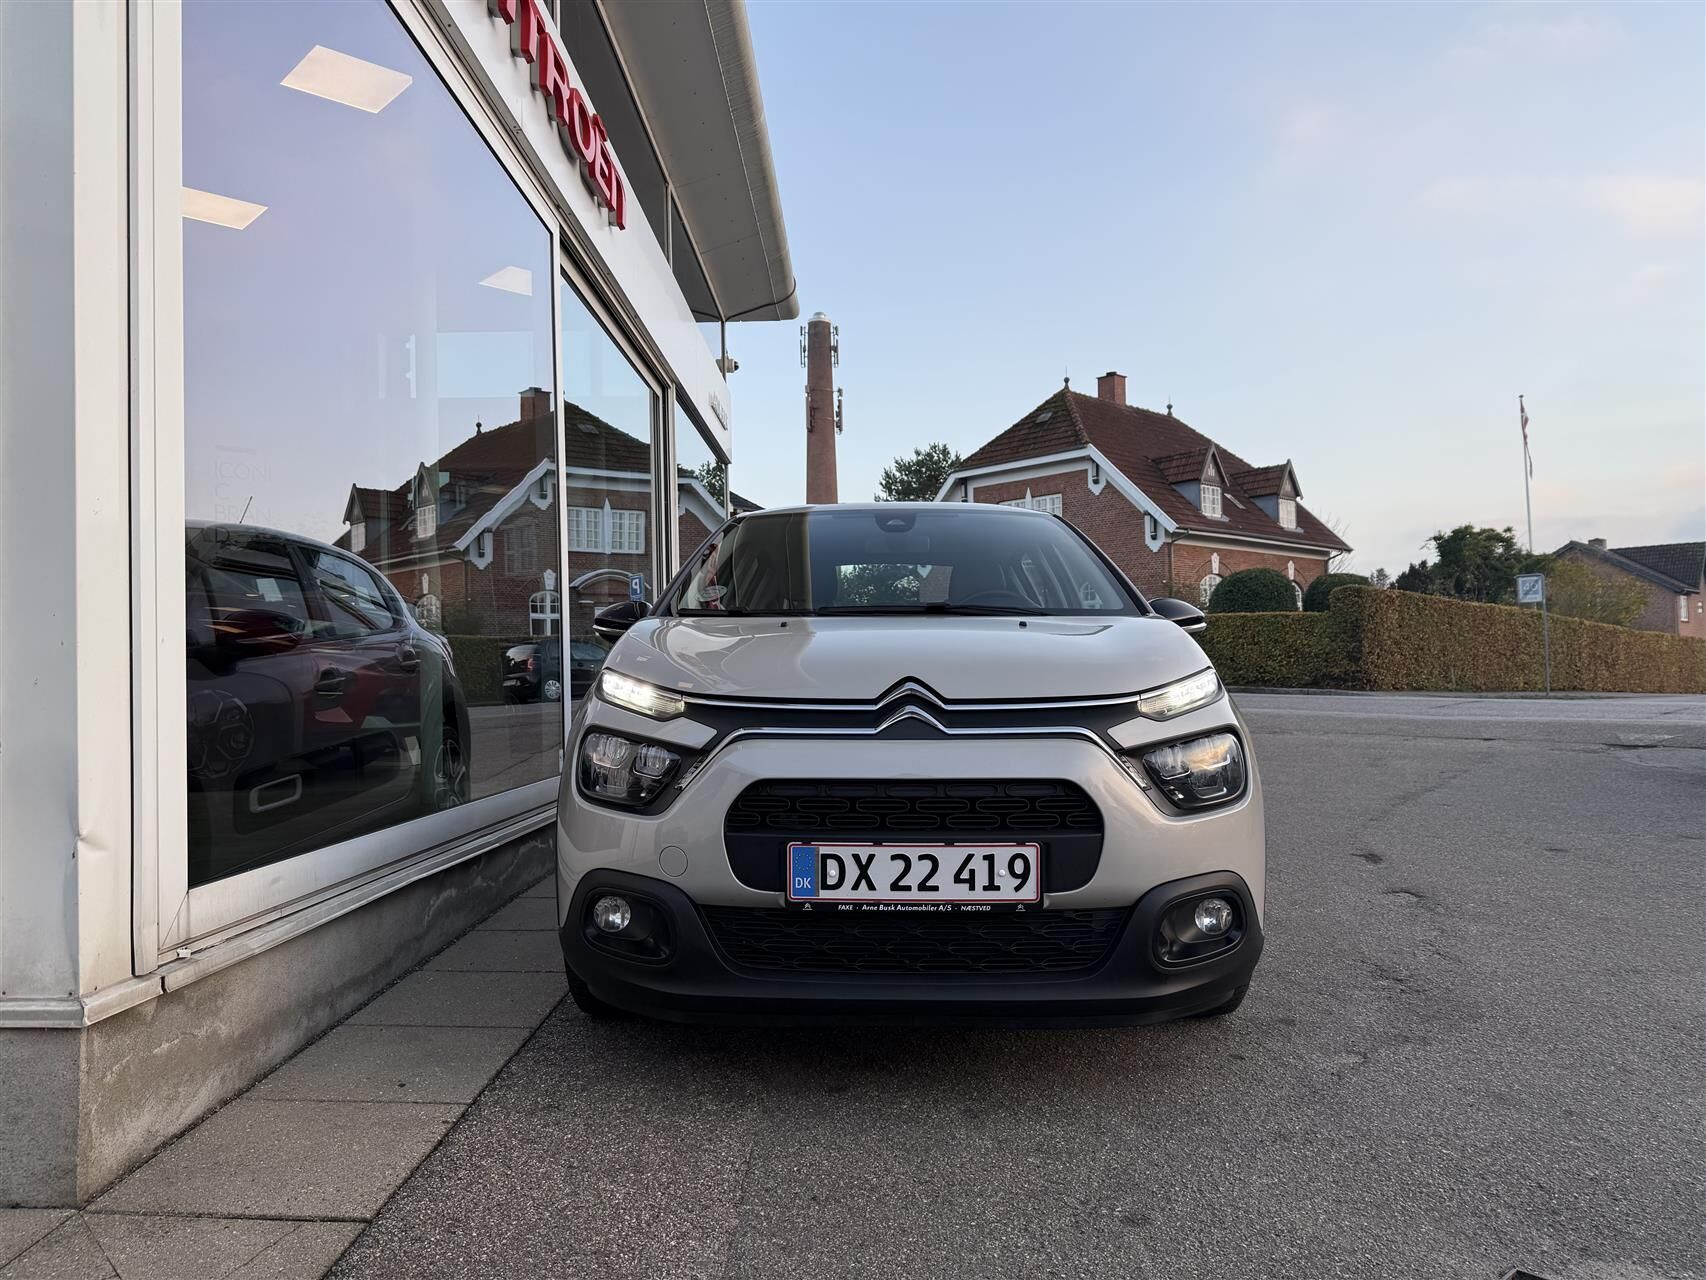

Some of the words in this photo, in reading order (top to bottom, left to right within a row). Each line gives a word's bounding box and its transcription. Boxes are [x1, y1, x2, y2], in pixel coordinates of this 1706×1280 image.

[820, 853, 877, 892] DX
[889, 853, 940, 892] 22
[953, 852, 1032, 893] 419
[794, 877, 812, 889] DK
[938, 904, 952, 912] A/S
